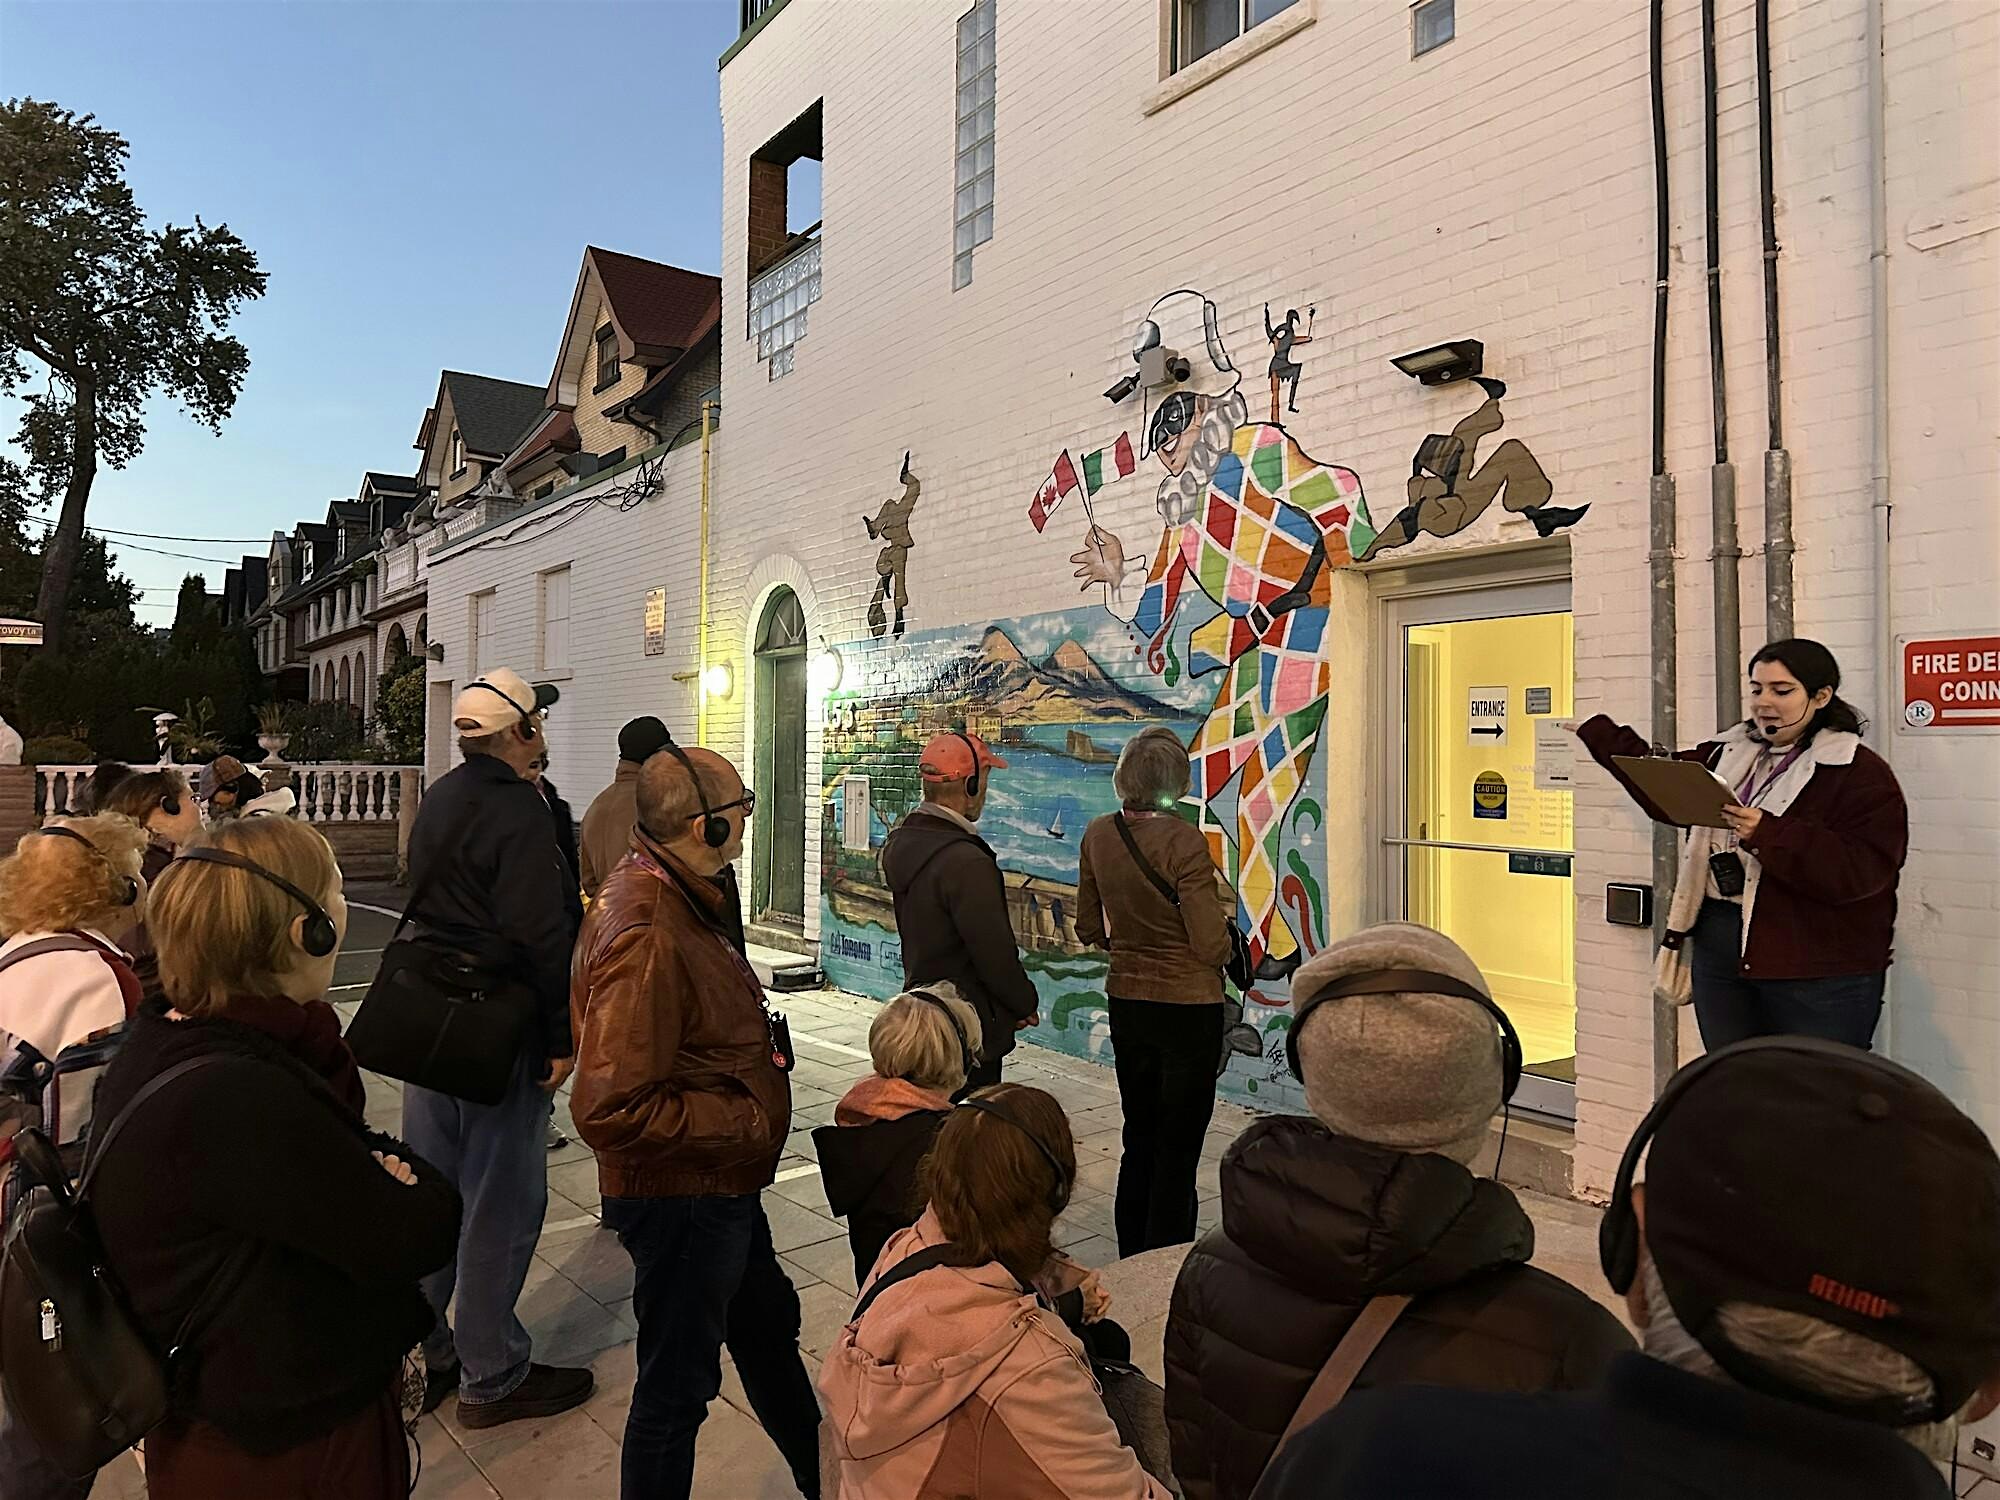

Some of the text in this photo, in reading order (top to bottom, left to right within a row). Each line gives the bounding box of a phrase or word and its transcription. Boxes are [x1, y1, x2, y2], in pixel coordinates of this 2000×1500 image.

[1911, 651, 2000, 674] FIRE DE
[1940, 680, 2000, 702] CONN
[1471, 700, 1505, 717] ENTRANCE
[1476, 784, 1506, 793] CAUTION
